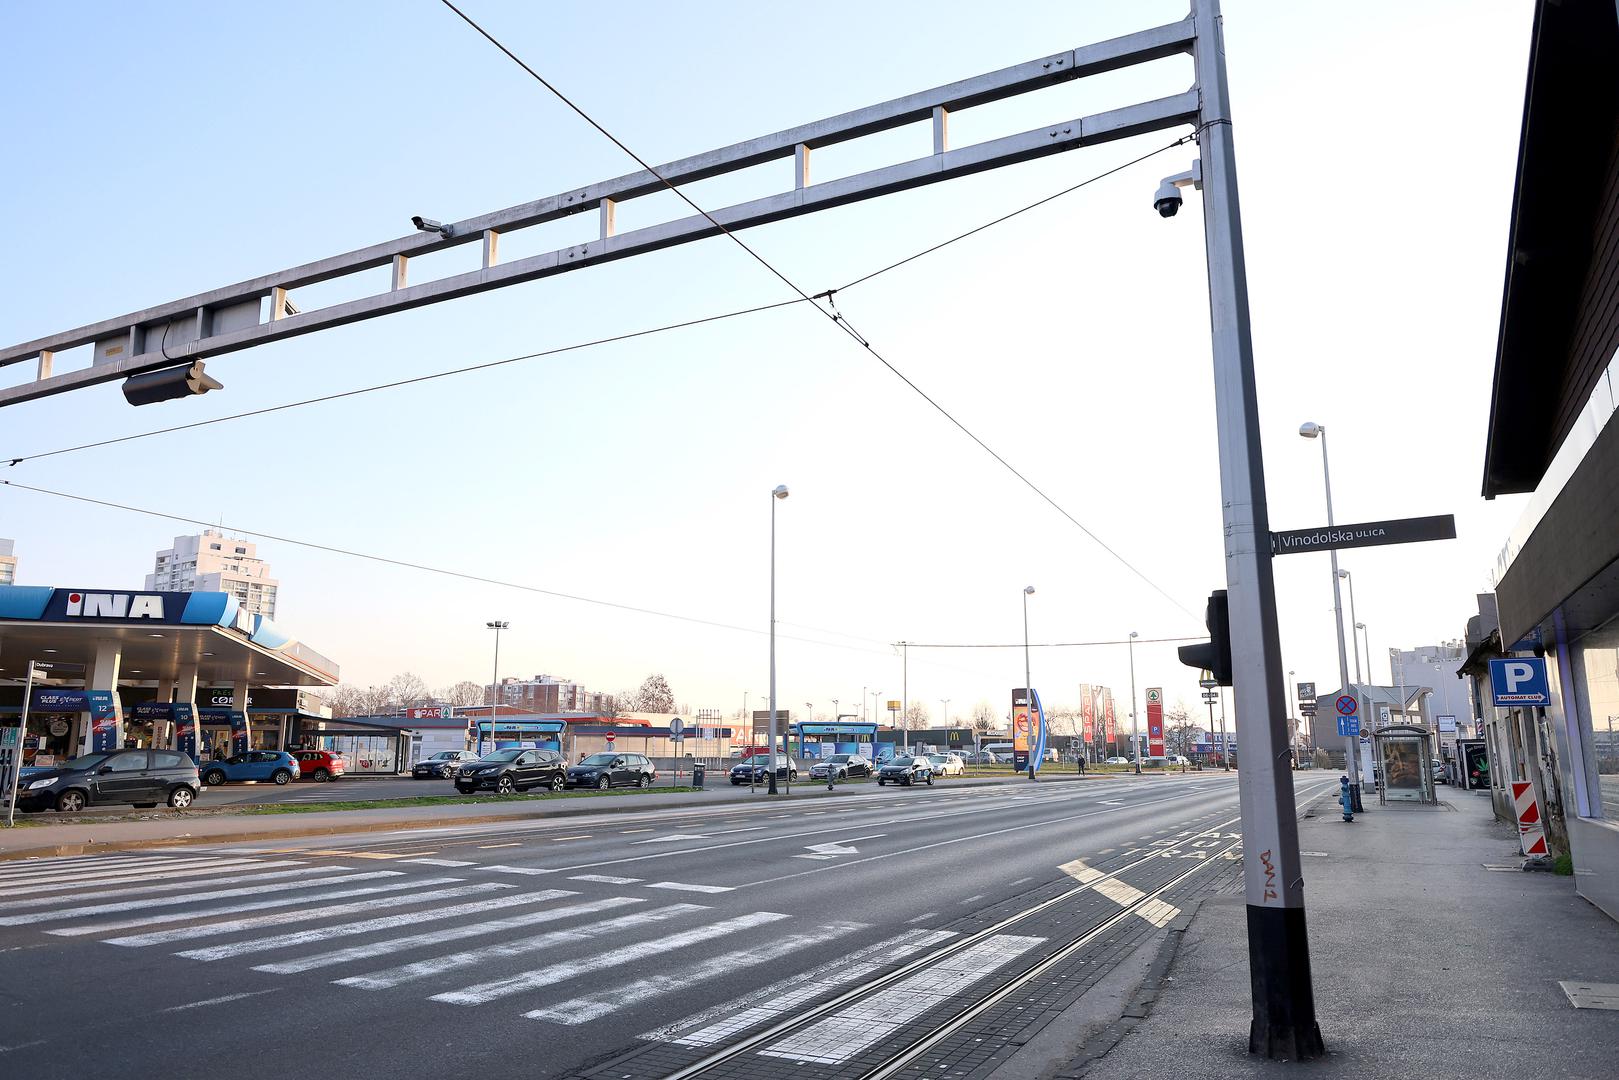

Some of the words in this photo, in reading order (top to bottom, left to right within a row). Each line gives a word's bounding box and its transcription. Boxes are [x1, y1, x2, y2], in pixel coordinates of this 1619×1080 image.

[1282, 530, 1354, 547] Vinodolska
[1355, 529, 1386, 538] ULICA
[1504, 662, 1534, 693] P
[211, 696, 253, 704] CORR
[1176, 831, 1242, 839] TAX
